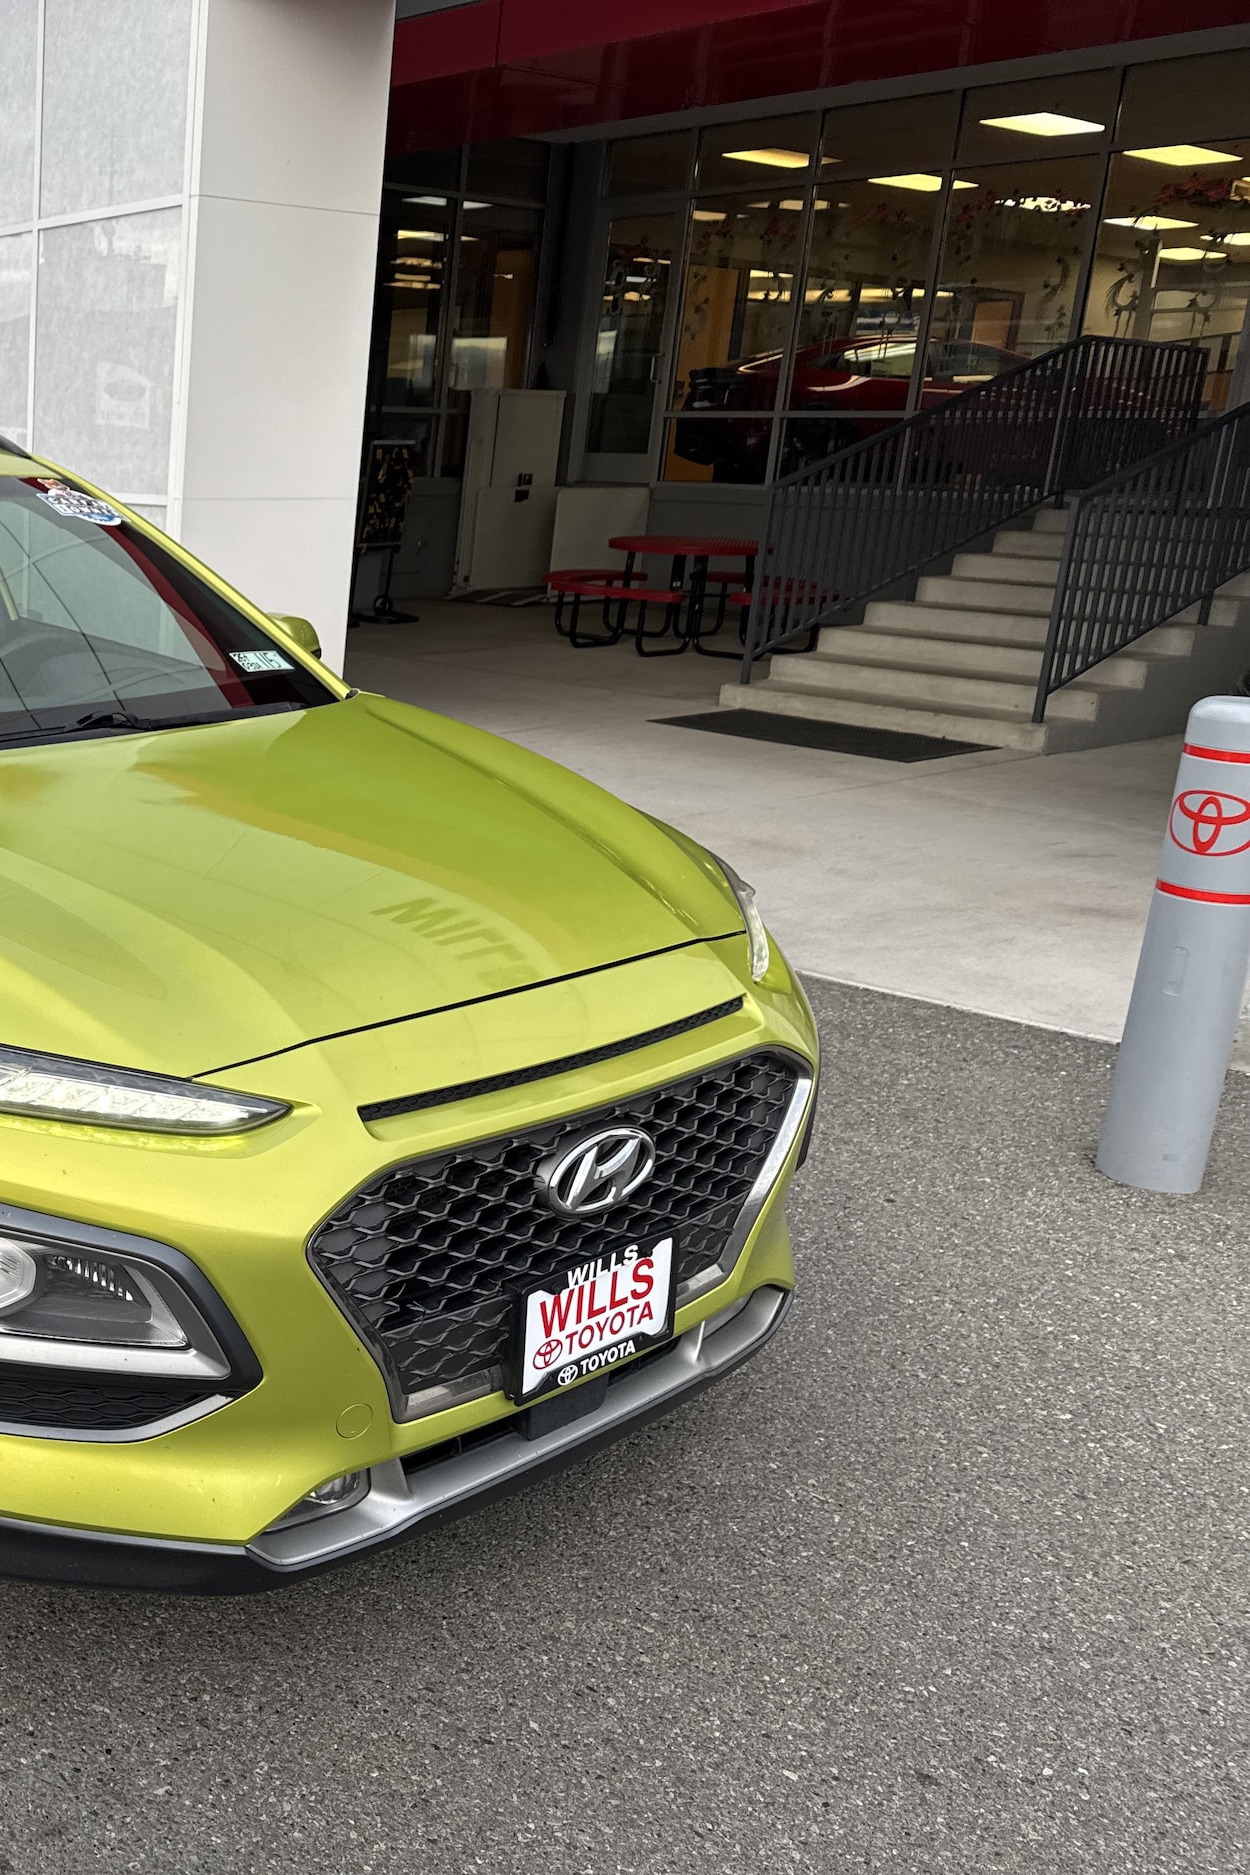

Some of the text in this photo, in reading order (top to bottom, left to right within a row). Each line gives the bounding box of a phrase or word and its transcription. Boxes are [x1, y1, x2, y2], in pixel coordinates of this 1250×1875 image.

[567, 1245, 639, 1287] WILLS
[539, 1257, 654, 1338] WILLS
[566, 1301, 654, 1354] TOYOTA
[580, 1339, 636, 1374] TOYOTA
